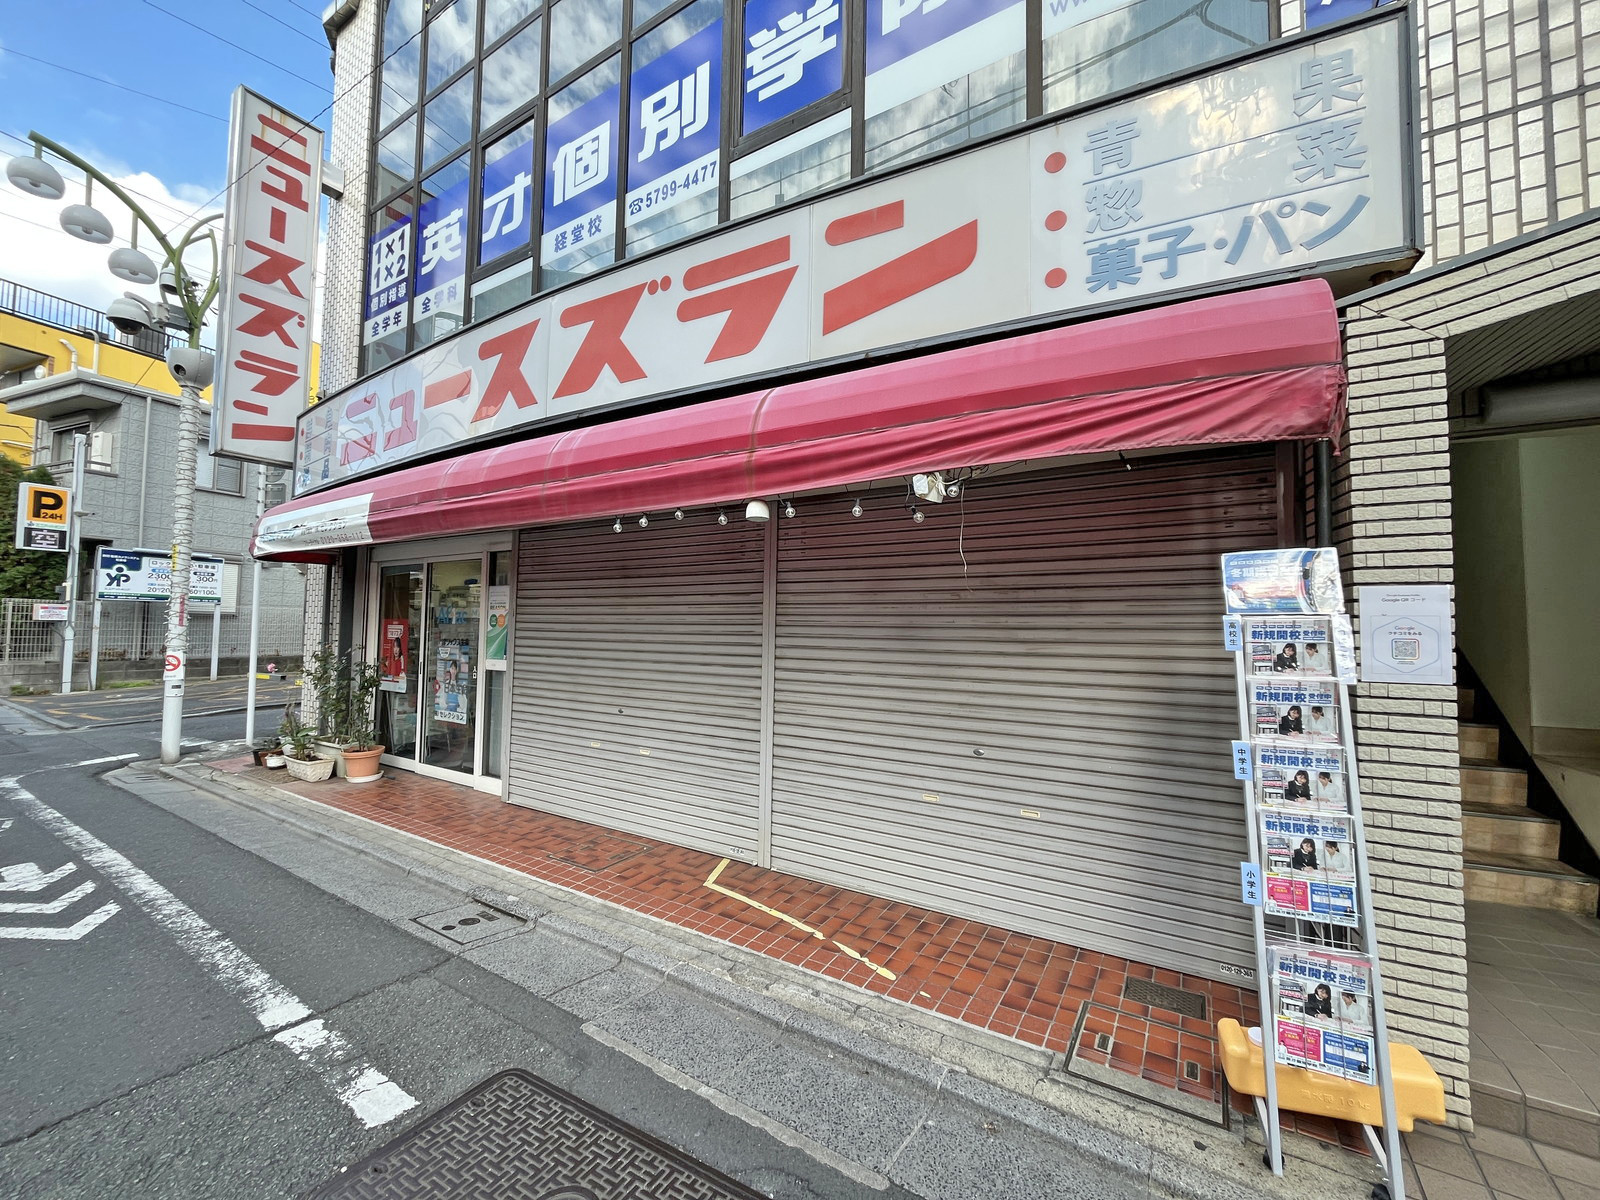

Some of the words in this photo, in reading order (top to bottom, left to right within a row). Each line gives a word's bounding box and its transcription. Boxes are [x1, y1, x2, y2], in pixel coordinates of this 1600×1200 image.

[554, 213, 603, 254] 経堂校
[231, 111, 312, 442] ニュースズラン
[370, 281, 407, 313] 個別指導
[421, 282, 458, 315] 全学科
[339, 199, 978, 468] ニュースズラン
[371, 310, 402, 338] 全学年
[32, 490, 64, 518] P
[41, 511, 63, 520] 24H
[1228, 621, 1238, 646] 高校生
[1251, 629, 1301, 641] 新規開校
[1302, 629, 1326, 637] 受付中
[1255, 691, 1307, 704] 新規開校
[1308, 692, 1332, 702] 受付中
[1237, 748, 1248, 775] 中学生
[1260, 753, 1314, 768] 新規開校
[1315, 757, 1340, 766] 受付中
[1265, 820, 1320, 836] 新規開校
[1321, 825, 1347, 834] 受付中
[1245, 869, 1257, 901] 小学生
[1279, 961, 1337, 983] 新規開校
[1338, 973, 1366, 985] 受付中
